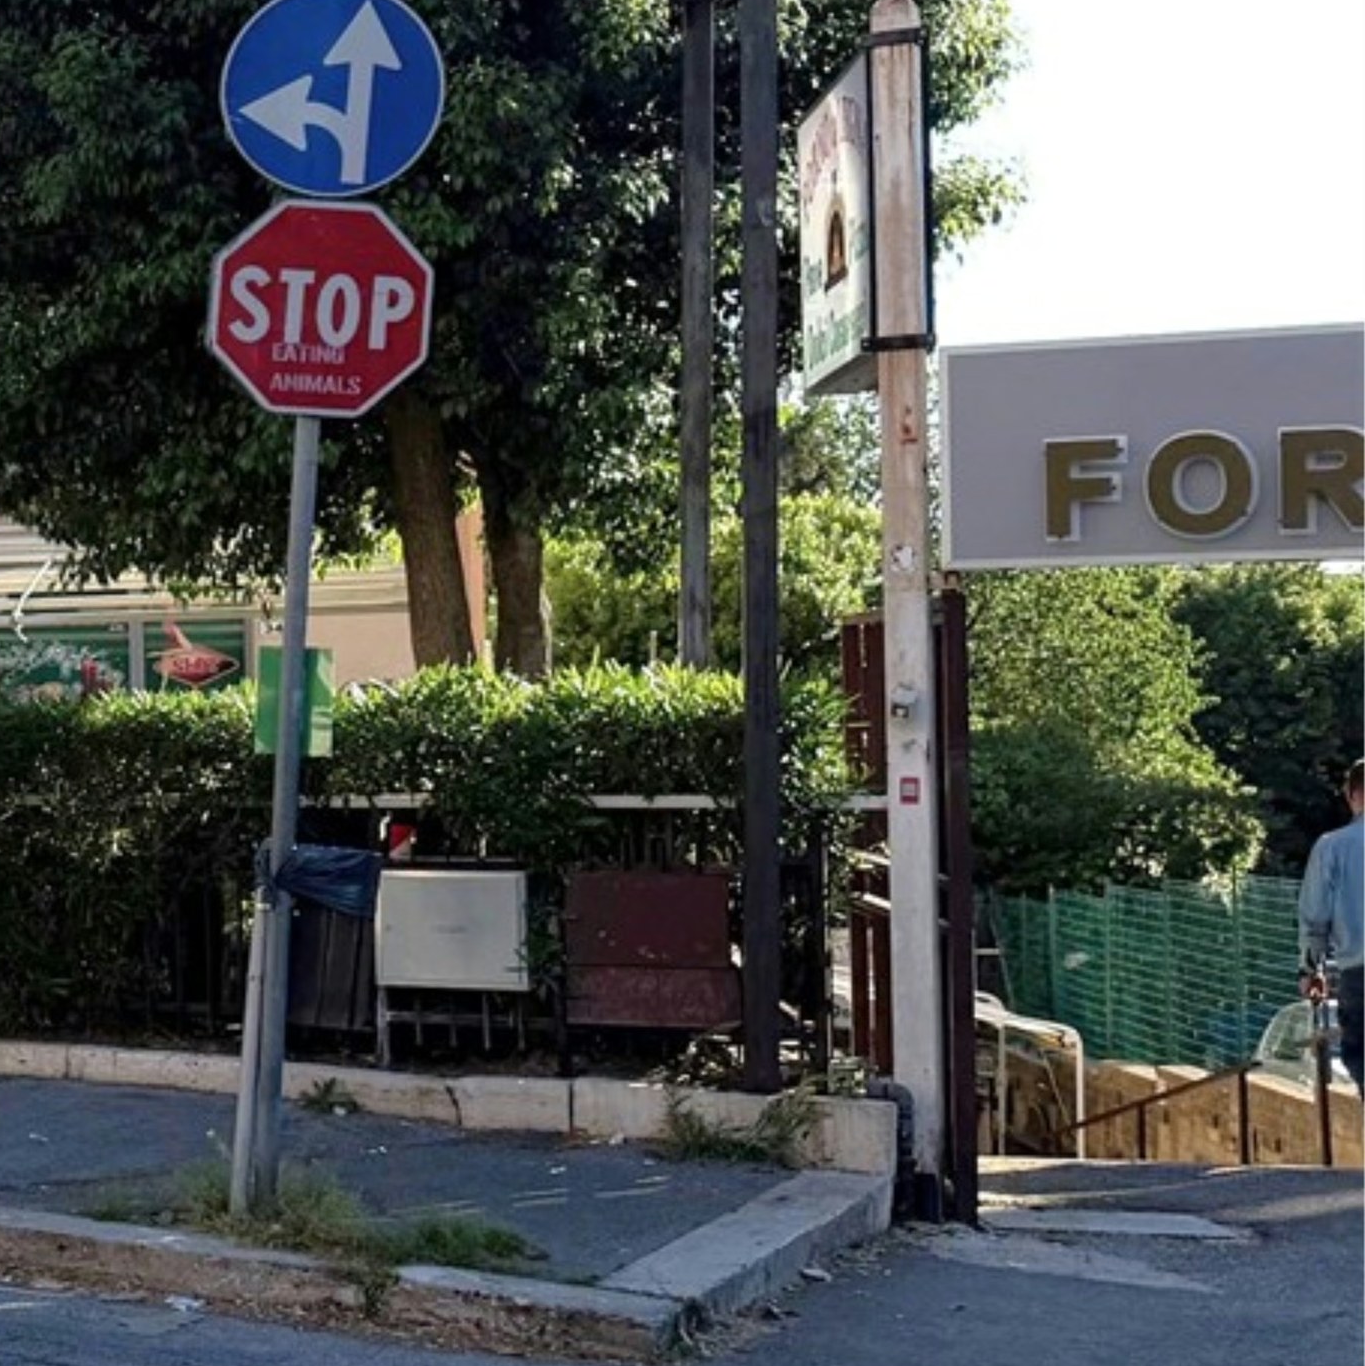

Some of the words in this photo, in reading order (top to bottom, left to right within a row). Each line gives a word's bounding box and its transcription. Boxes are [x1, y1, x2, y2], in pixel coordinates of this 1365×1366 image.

[228, 264, 415, 350] STOP
[272, 343, 346, 365] EATING
[270, 372, 362, 395] ANIMALS
